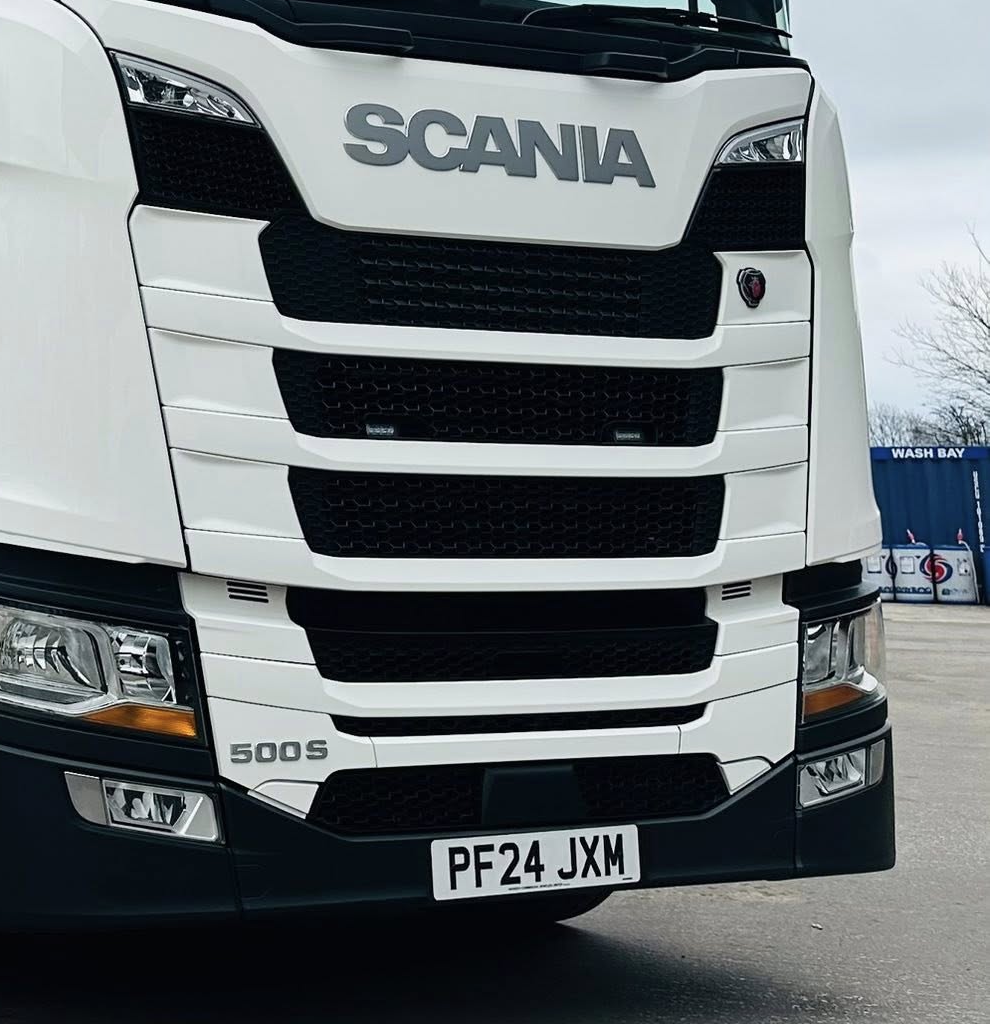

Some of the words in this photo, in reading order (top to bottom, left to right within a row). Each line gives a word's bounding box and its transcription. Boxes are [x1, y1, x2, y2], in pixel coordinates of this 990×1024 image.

[343, 102, 656, 189] SCANIA
[891, 448, 934, 459] WASH
[937, 448, 965, 459] BAY
[448, 840, 545, 891] PF24
[557, 833, 625, 880] JXM
